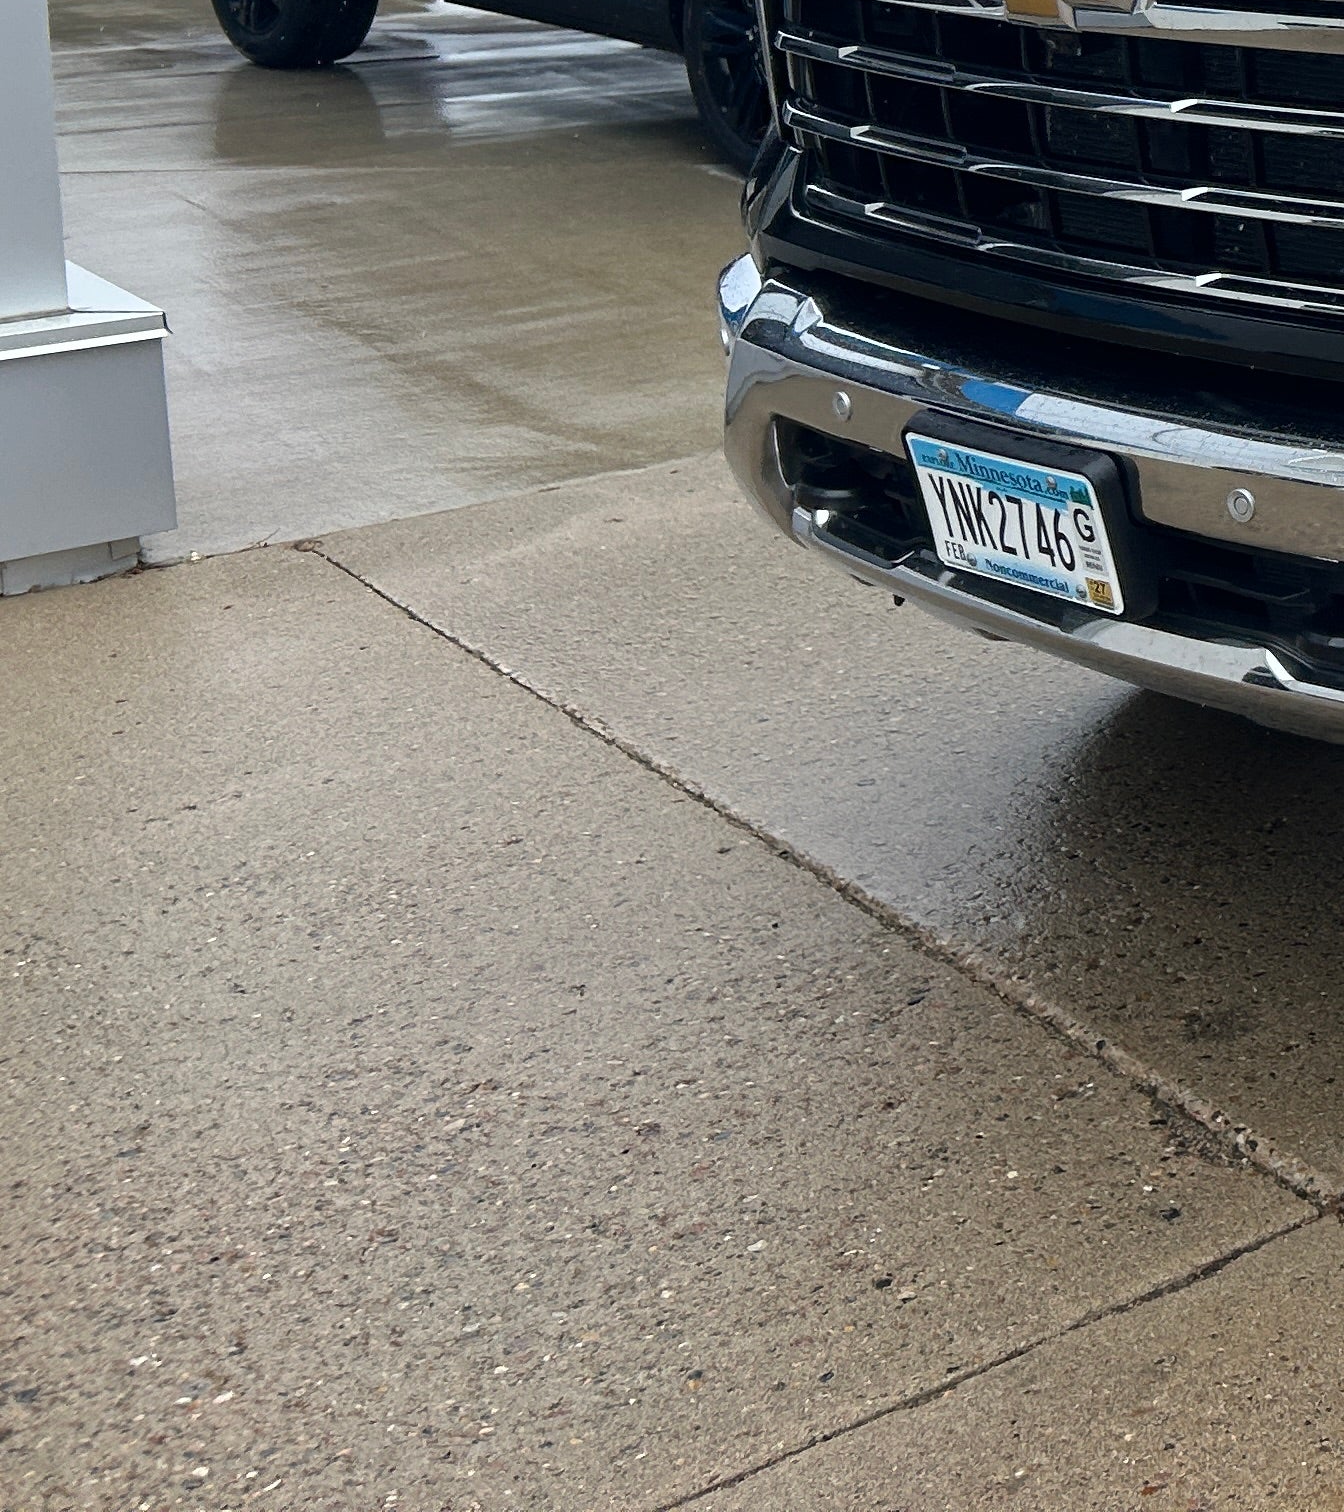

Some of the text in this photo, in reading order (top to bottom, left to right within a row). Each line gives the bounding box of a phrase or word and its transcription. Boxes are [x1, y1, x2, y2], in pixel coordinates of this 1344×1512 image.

[927, 472, 1096, 572] YNK2746 G
[945, 540, 968, 561] FEB
[984, 557, 1070, 593] Noncommercial
